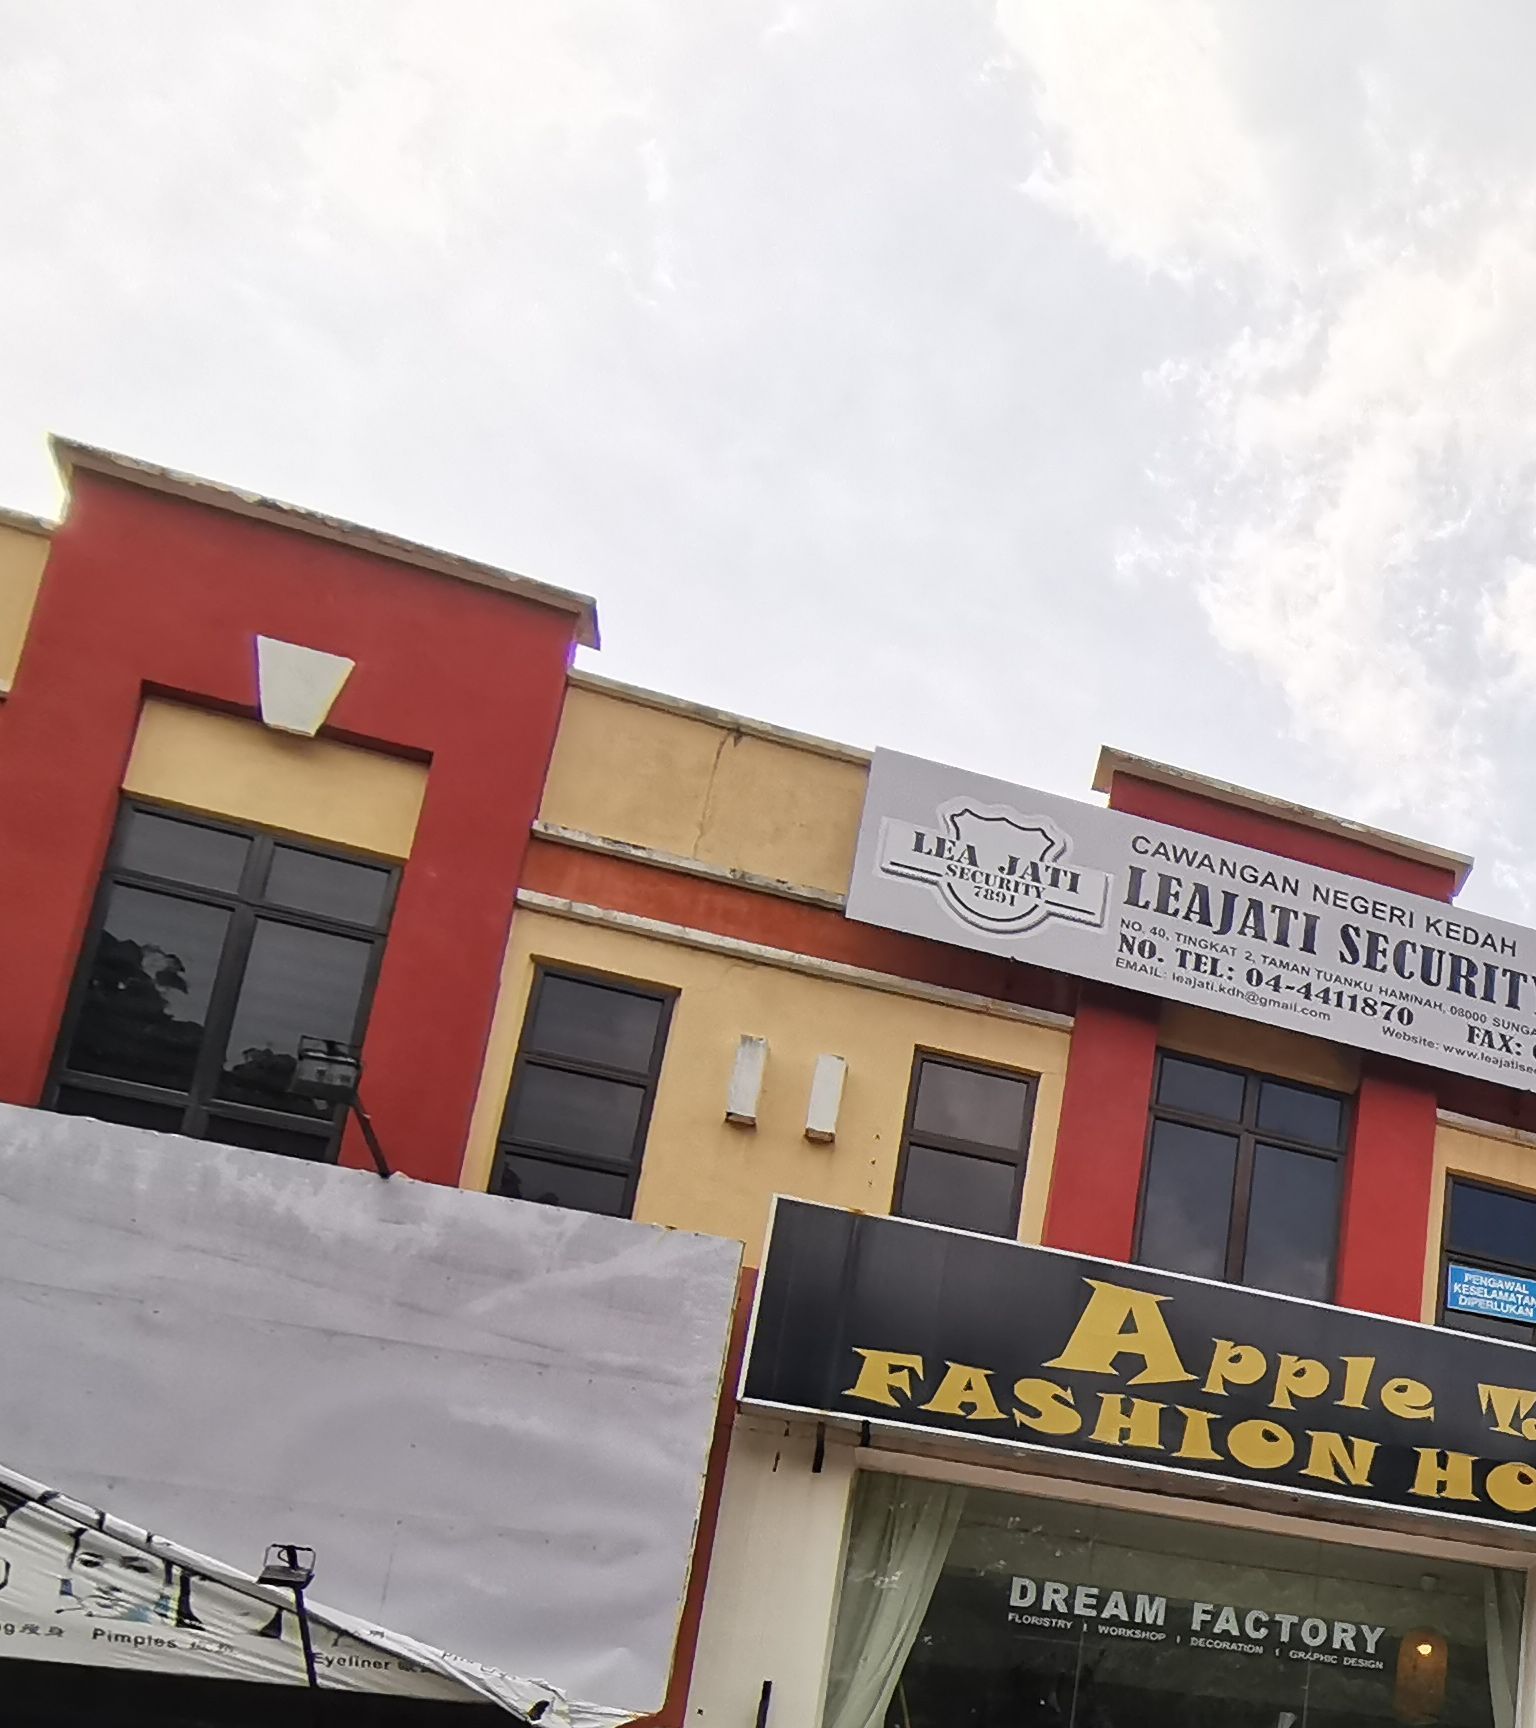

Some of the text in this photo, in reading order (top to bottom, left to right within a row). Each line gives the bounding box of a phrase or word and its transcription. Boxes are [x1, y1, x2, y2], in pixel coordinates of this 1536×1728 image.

[912, 831, 1082, 894] LEA JATI
[945, 863, 1046, 900] SECURITY
[973, 886, 1016, 908] 7891
[1131, 835, 1517, 957] CAWANGAN NEGERI KEDAH
[1122, 865, 1320, 955] LEAJATI
[1115, 957, 1168, 982] EMAIL:
[1172, 972, 1331, 1022] leajati.kdh@gmail.com
[1383, 1025, 1439, 1050] Website:
[1117, 932, 1164, 964] NO.
[1175, 948, 1235, 982] TEL:
[1245, 967, 1414, 1026] 04-4411870
[1467, 1023, 1522, 1057] FAX:
[1120, 918, 1147, 936] NO.
[1175, 931, 1237, 958] TINGKAT
[1244, 950, 1256, 965] 2,
[1261, 954, 1311, 977] TAMAN
[1315, 967, 1373, 993] TUANKU
[1379, 987, 1447, 1014] HAMINAH,
[1450, 1006, 1487, 1024] 08000
[1458, 1295, 1534, 1318] DIPERLUKAN
[1463, 1272, 1530, 1294] PENGAWAL
[1045, 1276, 1436, 1425] Apple
[841, 1345, 1382, 1488] FASHION
[92, 1628, 177, 1650] Pimples
[1007, 1611, 1384, 1670] FLORISTRY WORKSHOP DECORATION GRAPHIC DESIGN
[1009, 1576, 1385, 1654] DREAM FACTORY
[313, 1653, 391, 1671] Eyeliner
